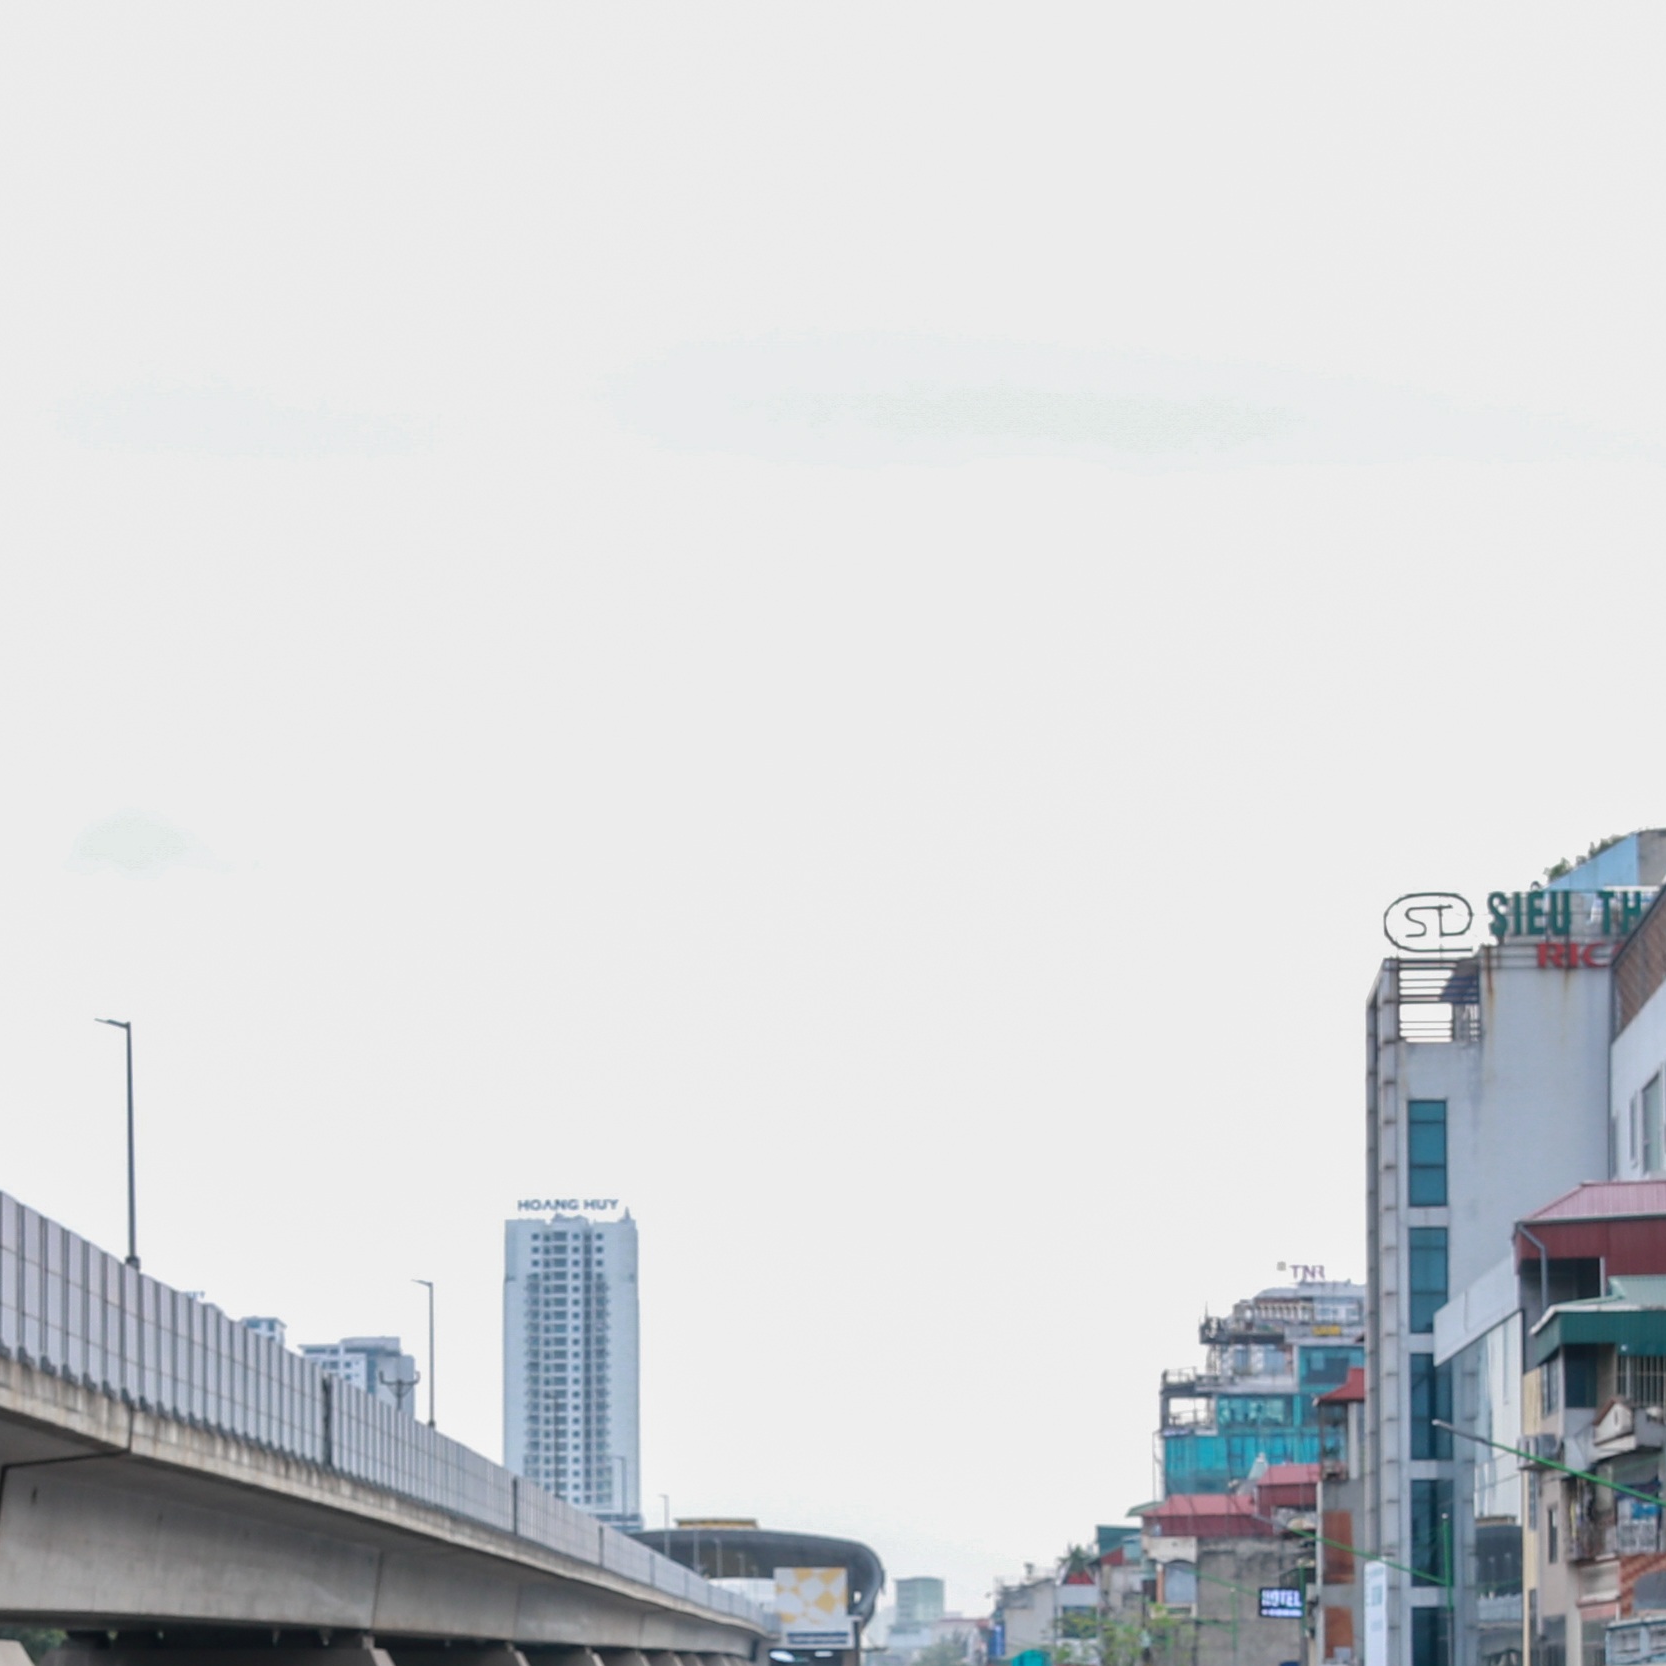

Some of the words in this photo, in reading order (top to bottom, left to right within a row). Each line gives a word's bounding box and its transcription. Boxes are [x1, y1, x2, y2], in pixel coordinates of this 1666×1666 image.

[1488, 881, 1571, 937] SIÊU
[1536, 941, 1618, 968] RIC
[583, 1198, 619, 1211] HUY
[1261, 1589, 1303, 1607] HOTEL
